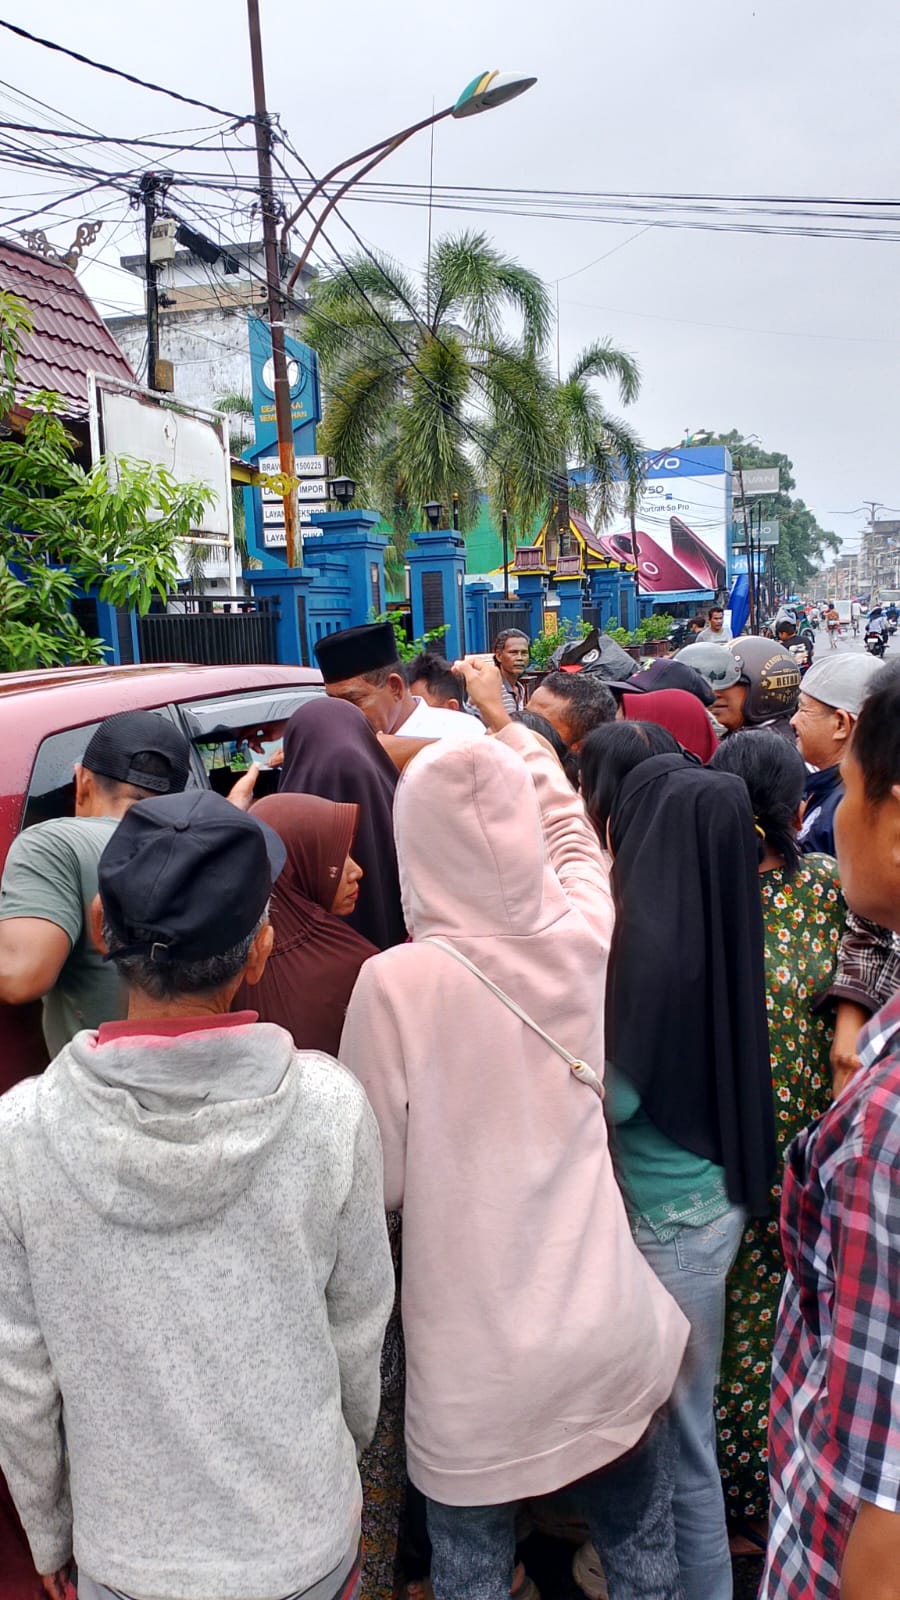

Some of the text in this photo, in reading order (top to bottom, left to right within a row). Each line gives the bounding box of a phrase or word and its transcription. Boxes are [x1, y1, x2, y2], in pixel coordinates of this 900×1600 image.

[262, 463, 280, 471] BRAV
[300, 484, 324, 494] IMPOR
[678, 503, 690, 511] Pro
[265, 510, 285, 519] LAYAN
[266, 533, 285, 542] LAYA
